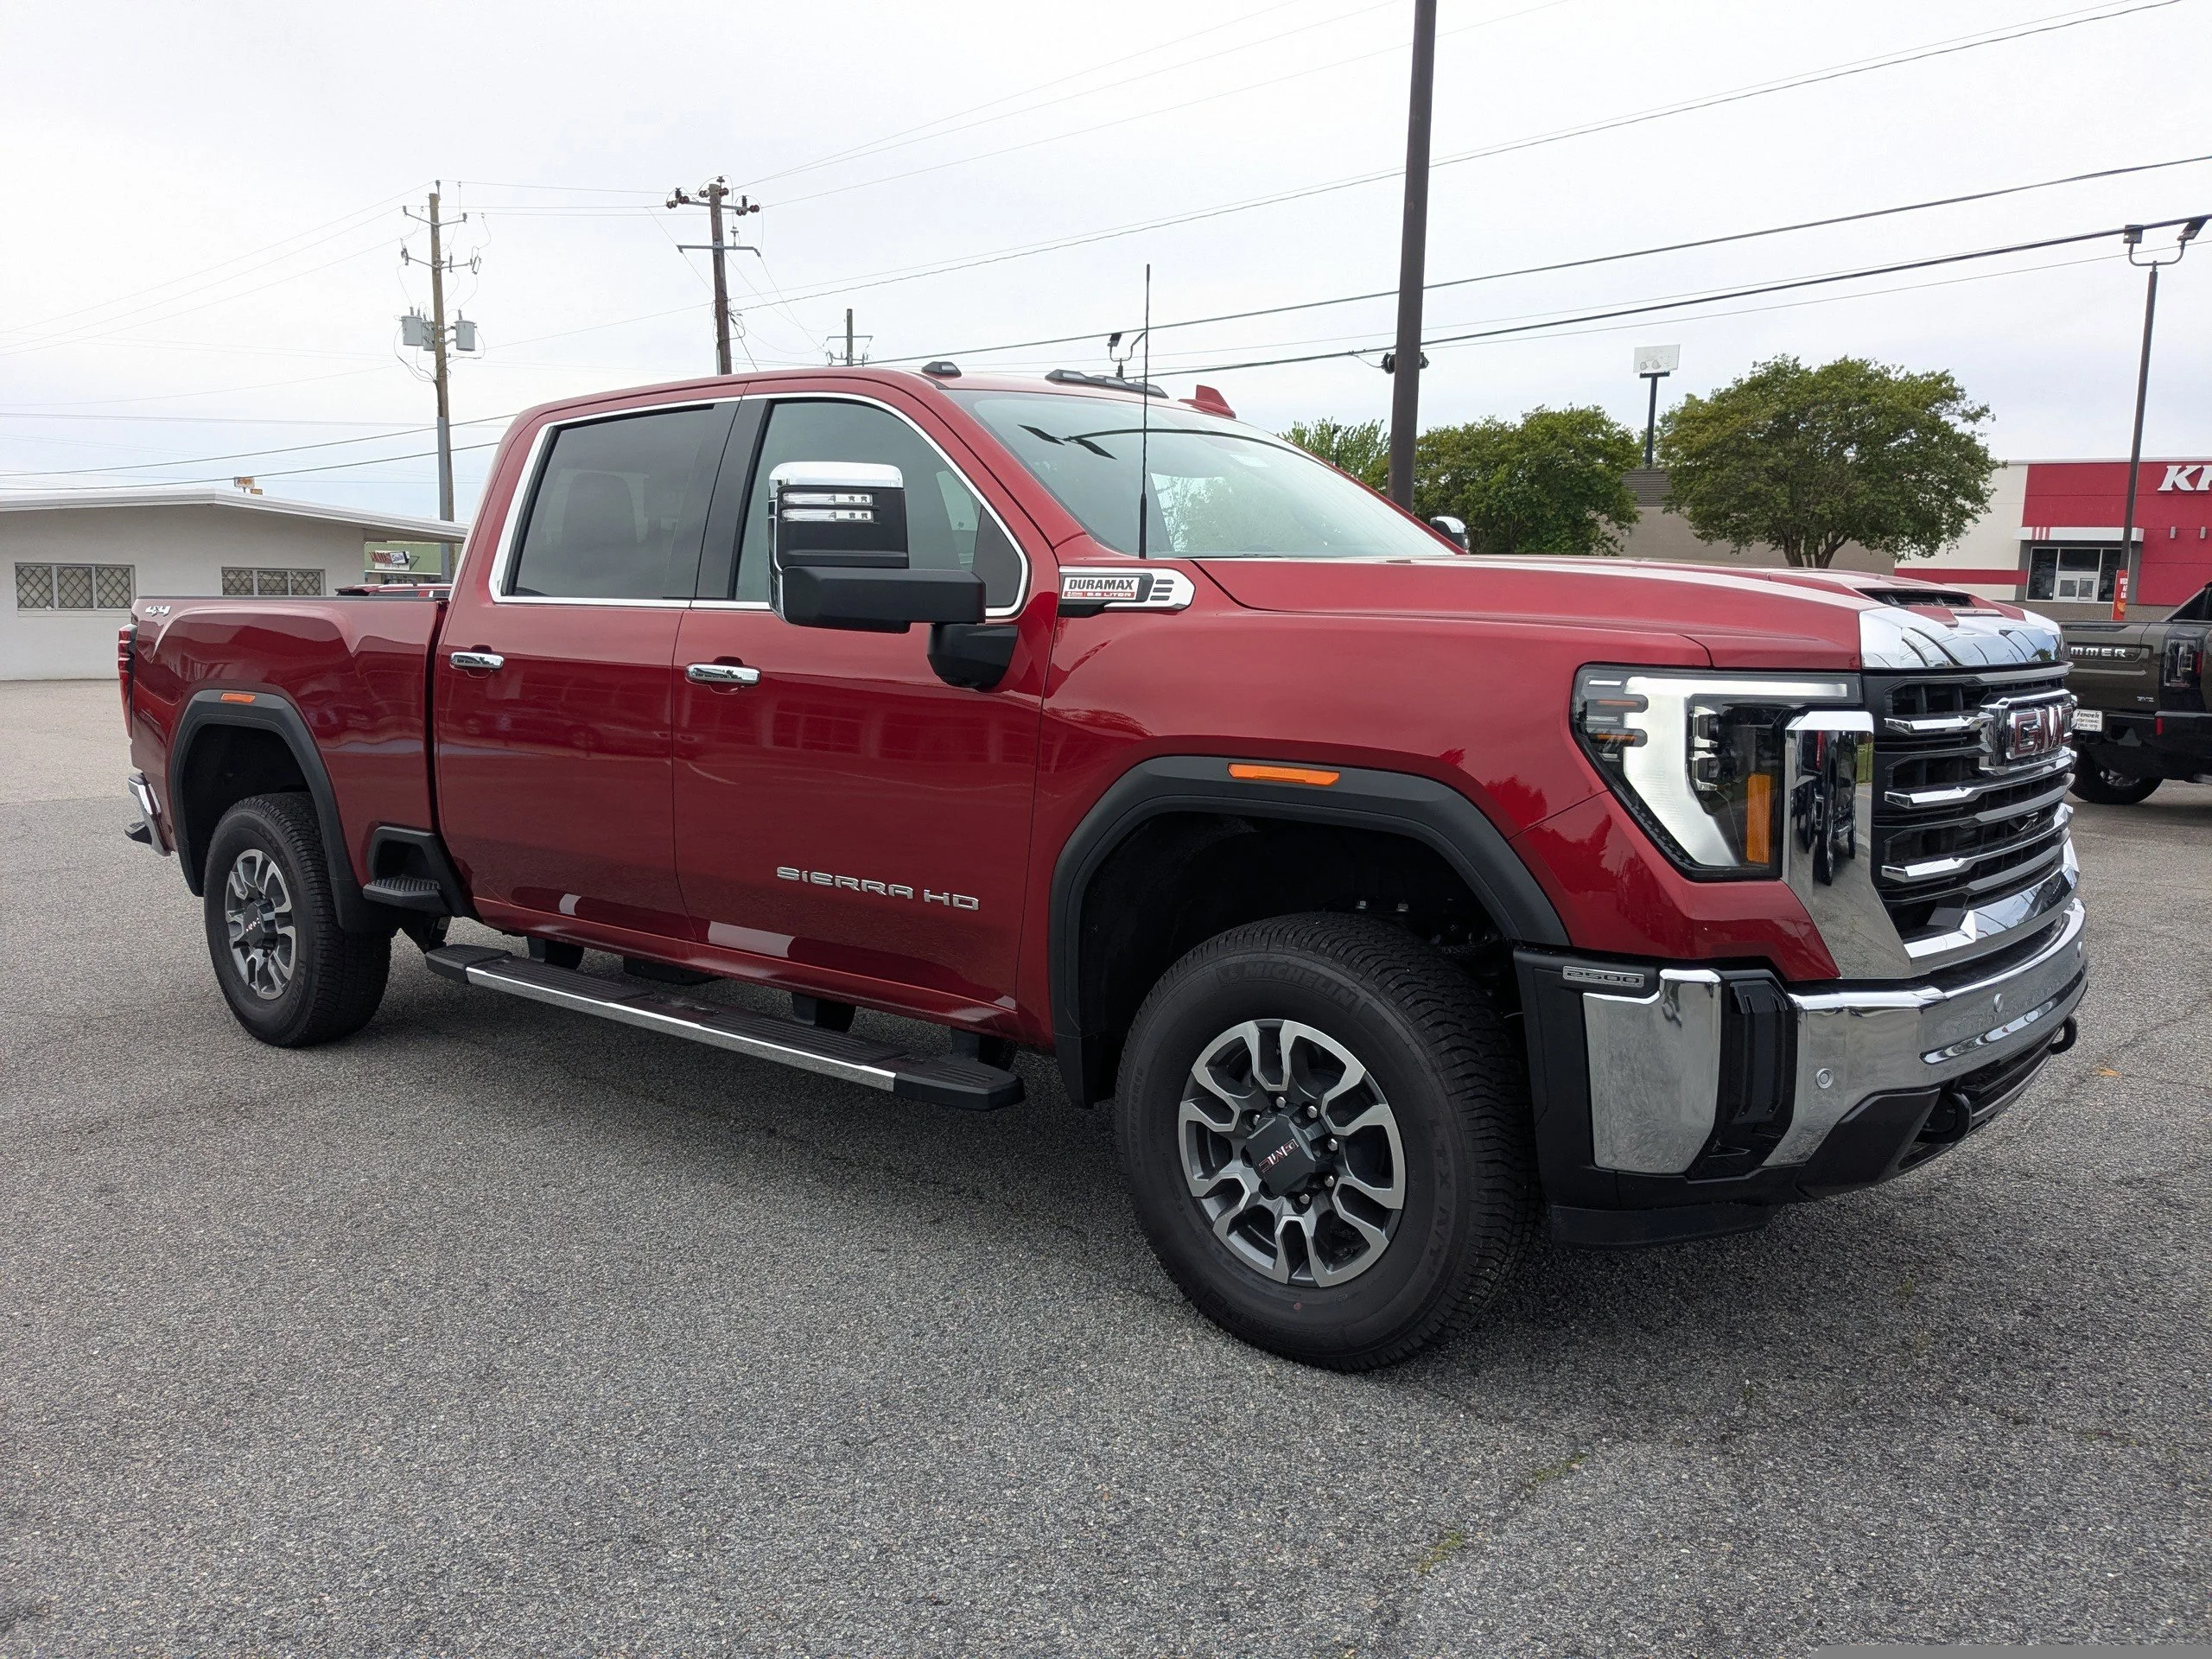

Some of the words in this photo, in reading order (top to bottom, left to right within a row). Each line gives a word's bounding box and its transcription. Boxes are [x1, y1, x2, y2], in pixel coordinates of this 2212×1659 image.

[1068, 579, 1135, 590] DURAMAX
[2070, 646, 2126, 658] MMER
[2011, 705, 2073, 755] GMC
[776, 866, 914, 900] SIERRA
[923, 888, 980, 911] HD
[1242, 961, 1360, 1014] MICHELIN
[1567, 970, 1640, 983] 2500
[1258, 1138, 1300, 1173] GMC
